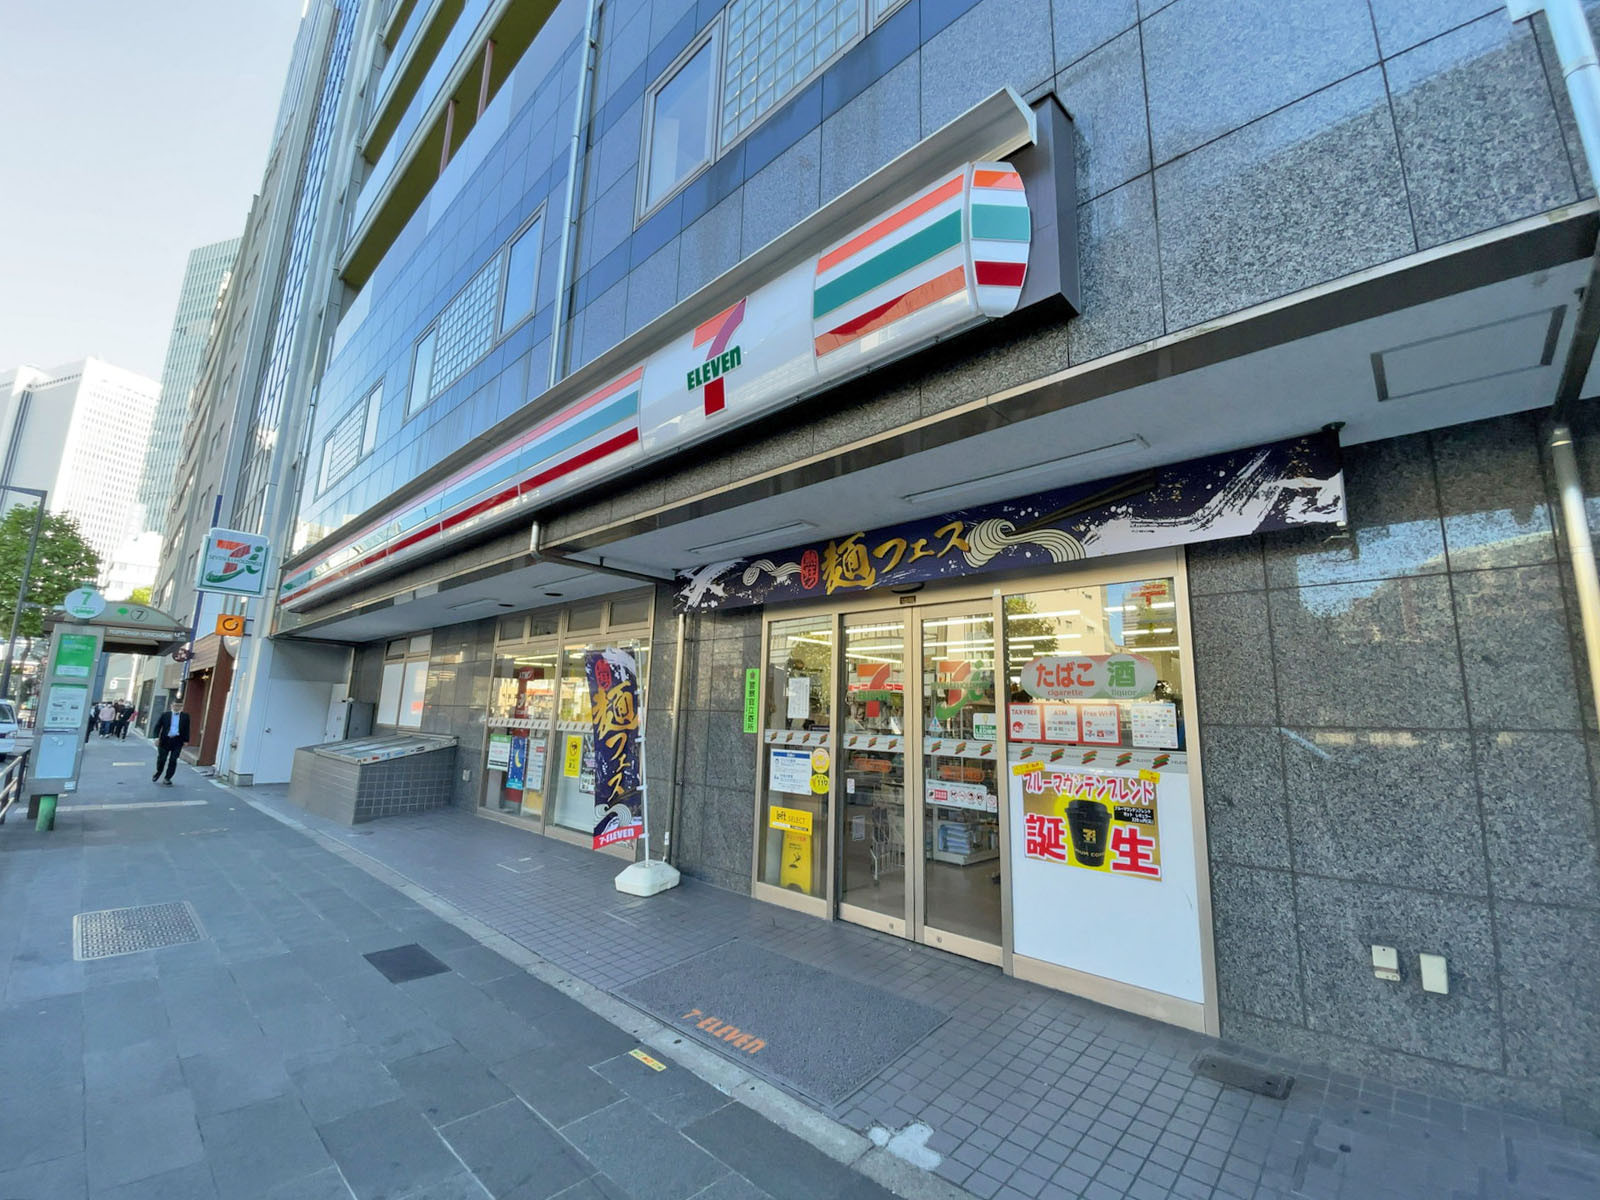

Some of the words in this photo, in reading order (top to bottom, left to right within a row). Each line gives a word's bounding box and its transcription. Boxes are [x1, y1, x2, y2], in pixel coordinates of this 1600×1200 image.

[692, 296, 748, 416] 7
[821, 521, 971, 595] 麺フェス
[81, 591, 93, 606] 7
[136, 610, 145, 620] 7
[1036, 661, 1095, 688] たばこ
[1108, 660, 1136, 688] 酒
[1047, 689, 1084, 697] cigarette
[1112, 688, 1136, 697] liquor
[592, 681, 639, 802] 麺フェス
[1023, 772, 1154, 804] ブルーマウンテンブレンド
